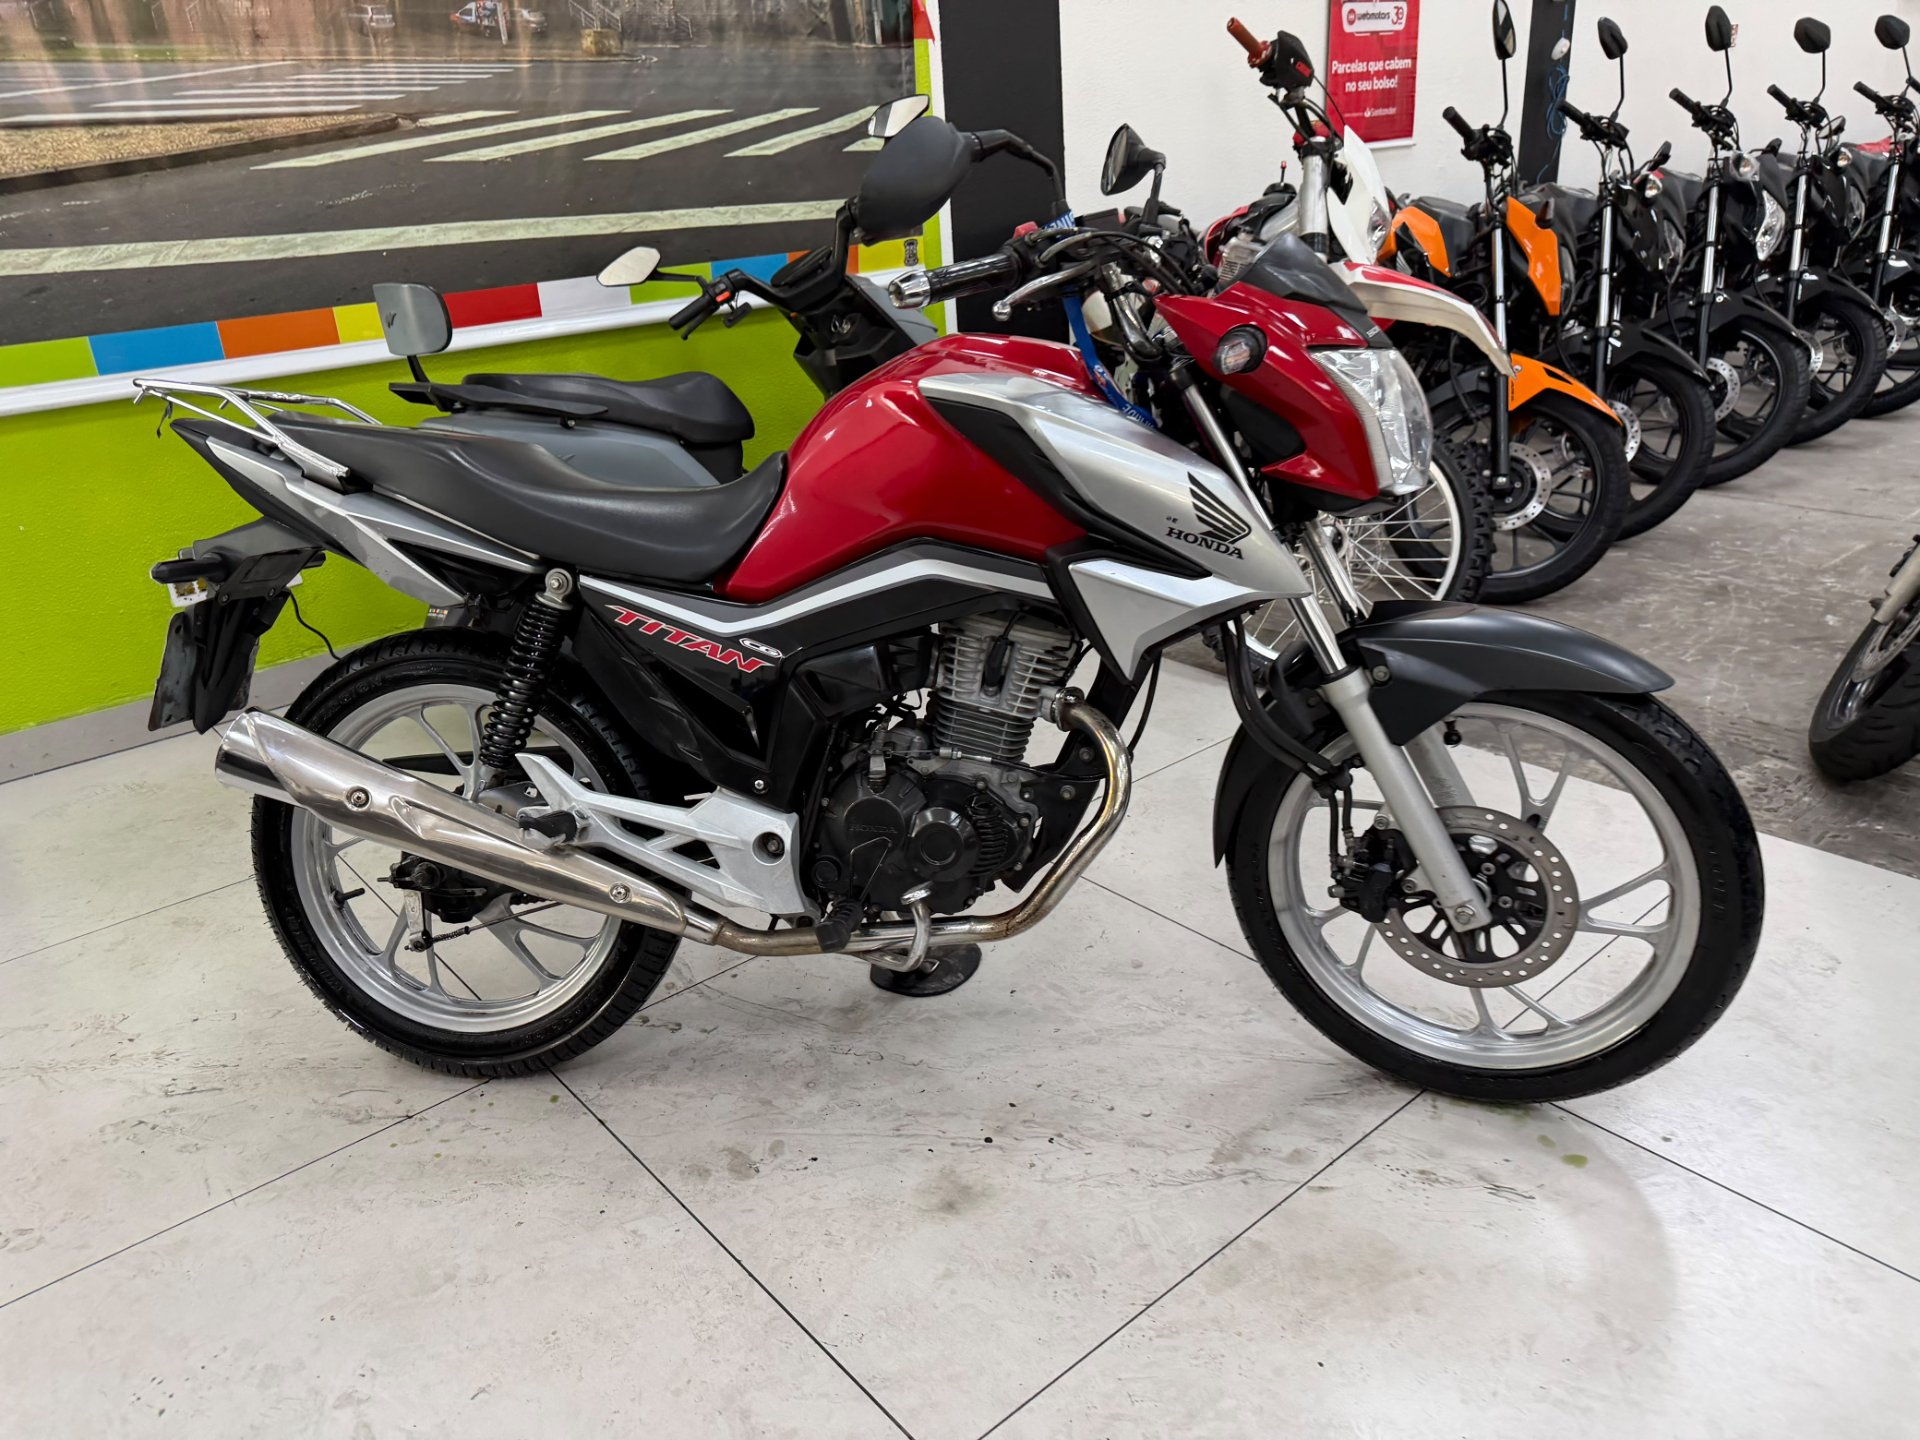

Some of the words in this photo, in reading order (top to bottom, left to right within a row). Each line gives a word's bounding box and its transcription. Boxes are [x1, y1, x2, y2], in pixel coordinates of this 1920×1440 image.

[1357, 11, 1390, 21] webmotors
[1332, 59, 1367, 74] Parcelas
[1368, 61, 1383, 75] que
[1385, 57, 1411, 71] cabem
[1345, 81, 1356, 93] no
[1358, 80, 1372, 91] seu
[1373, 75, 1398, 91] bolso!
[1165, 527, 1244, 560] HONDA
[604, 605, 776, 673] TITAN
